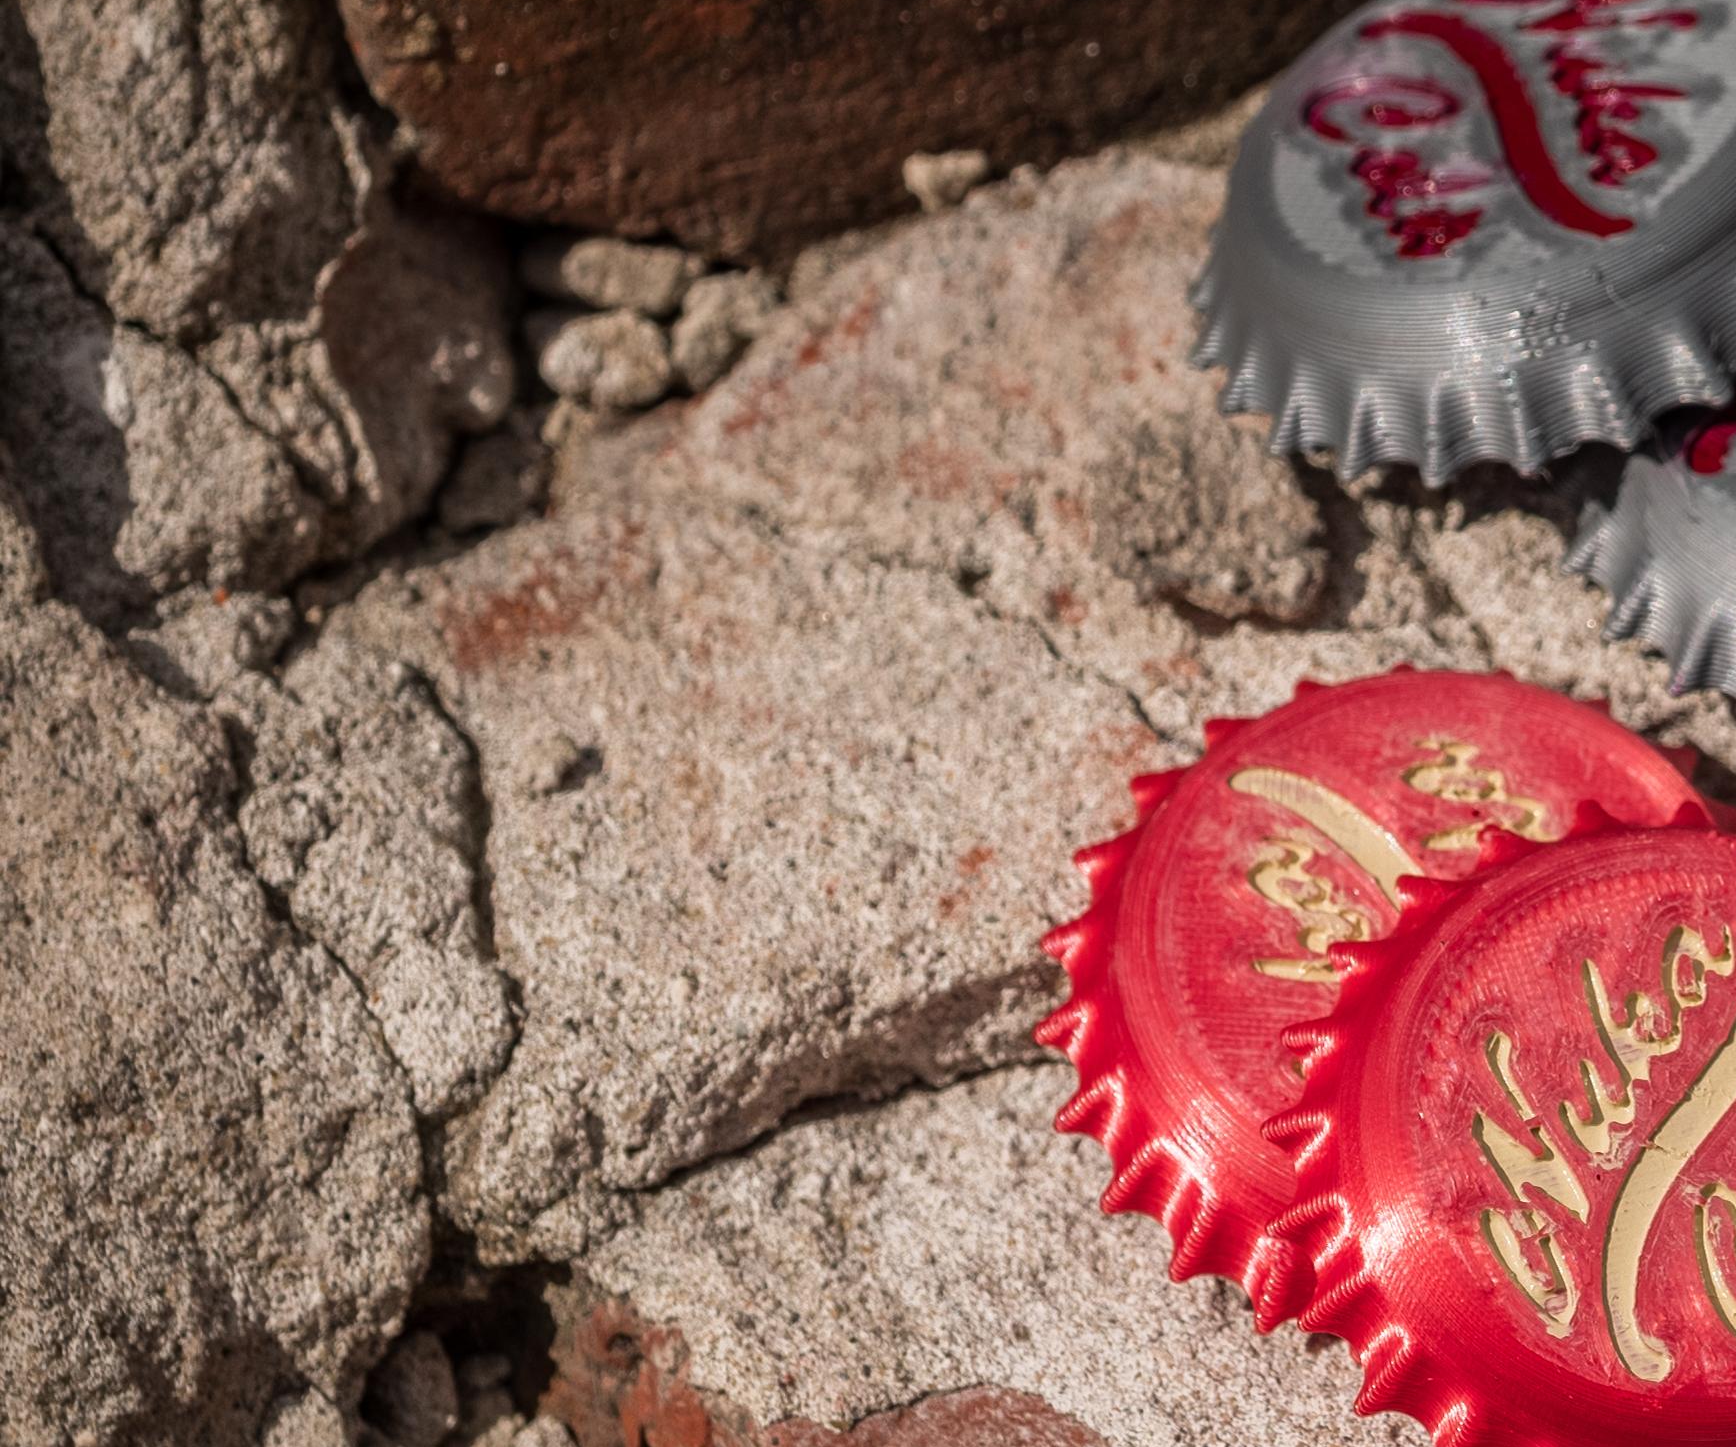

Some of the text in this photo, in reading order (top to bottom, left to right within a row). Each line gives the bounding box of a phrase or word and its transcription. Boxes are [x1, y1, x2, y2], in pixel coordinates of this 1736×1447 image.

[1302, 73, 1496, 259] Cola
[1247, 831, 1371, 984] ka
[1472, 923, 1735, 1338] Nuka
